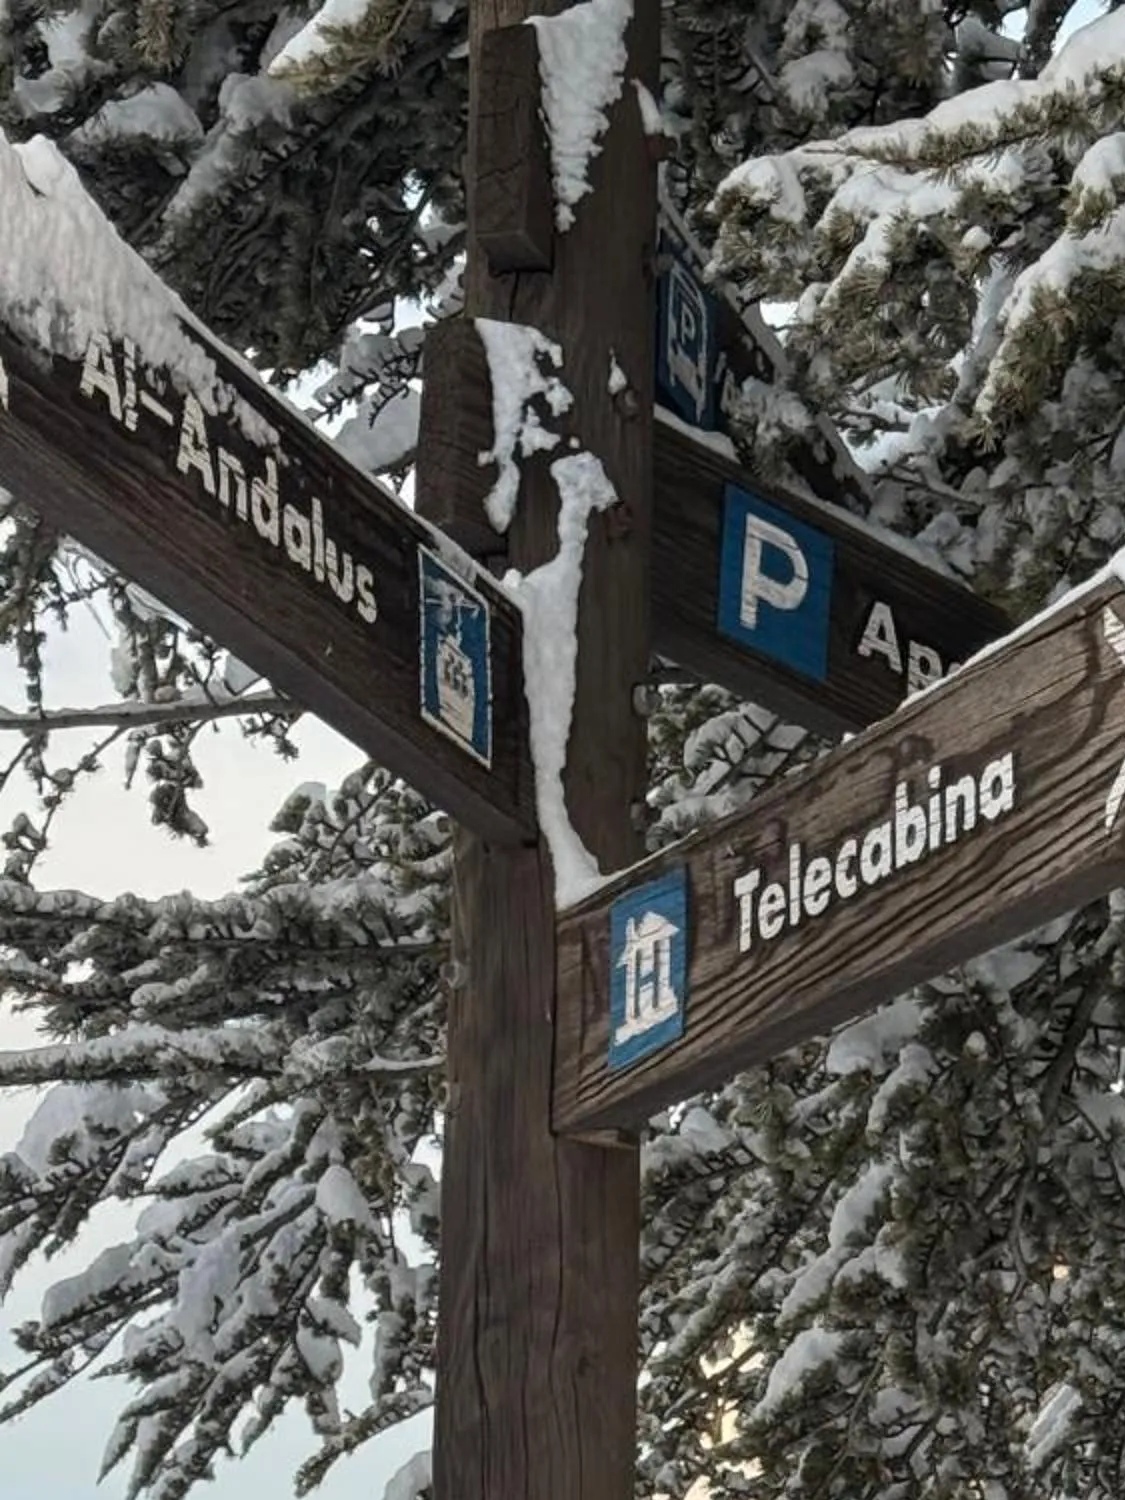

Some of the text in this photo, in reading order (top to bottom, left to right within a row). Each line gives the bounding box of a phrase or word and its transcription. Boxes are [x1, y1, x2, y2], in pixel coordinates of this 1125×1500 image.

[80, 333, 378, 624] Al-Andalus
[739, 512, 808, 630] P
[858, 601, 963, 699] Ap
[733, 751, 1017, 953] Telecabina
